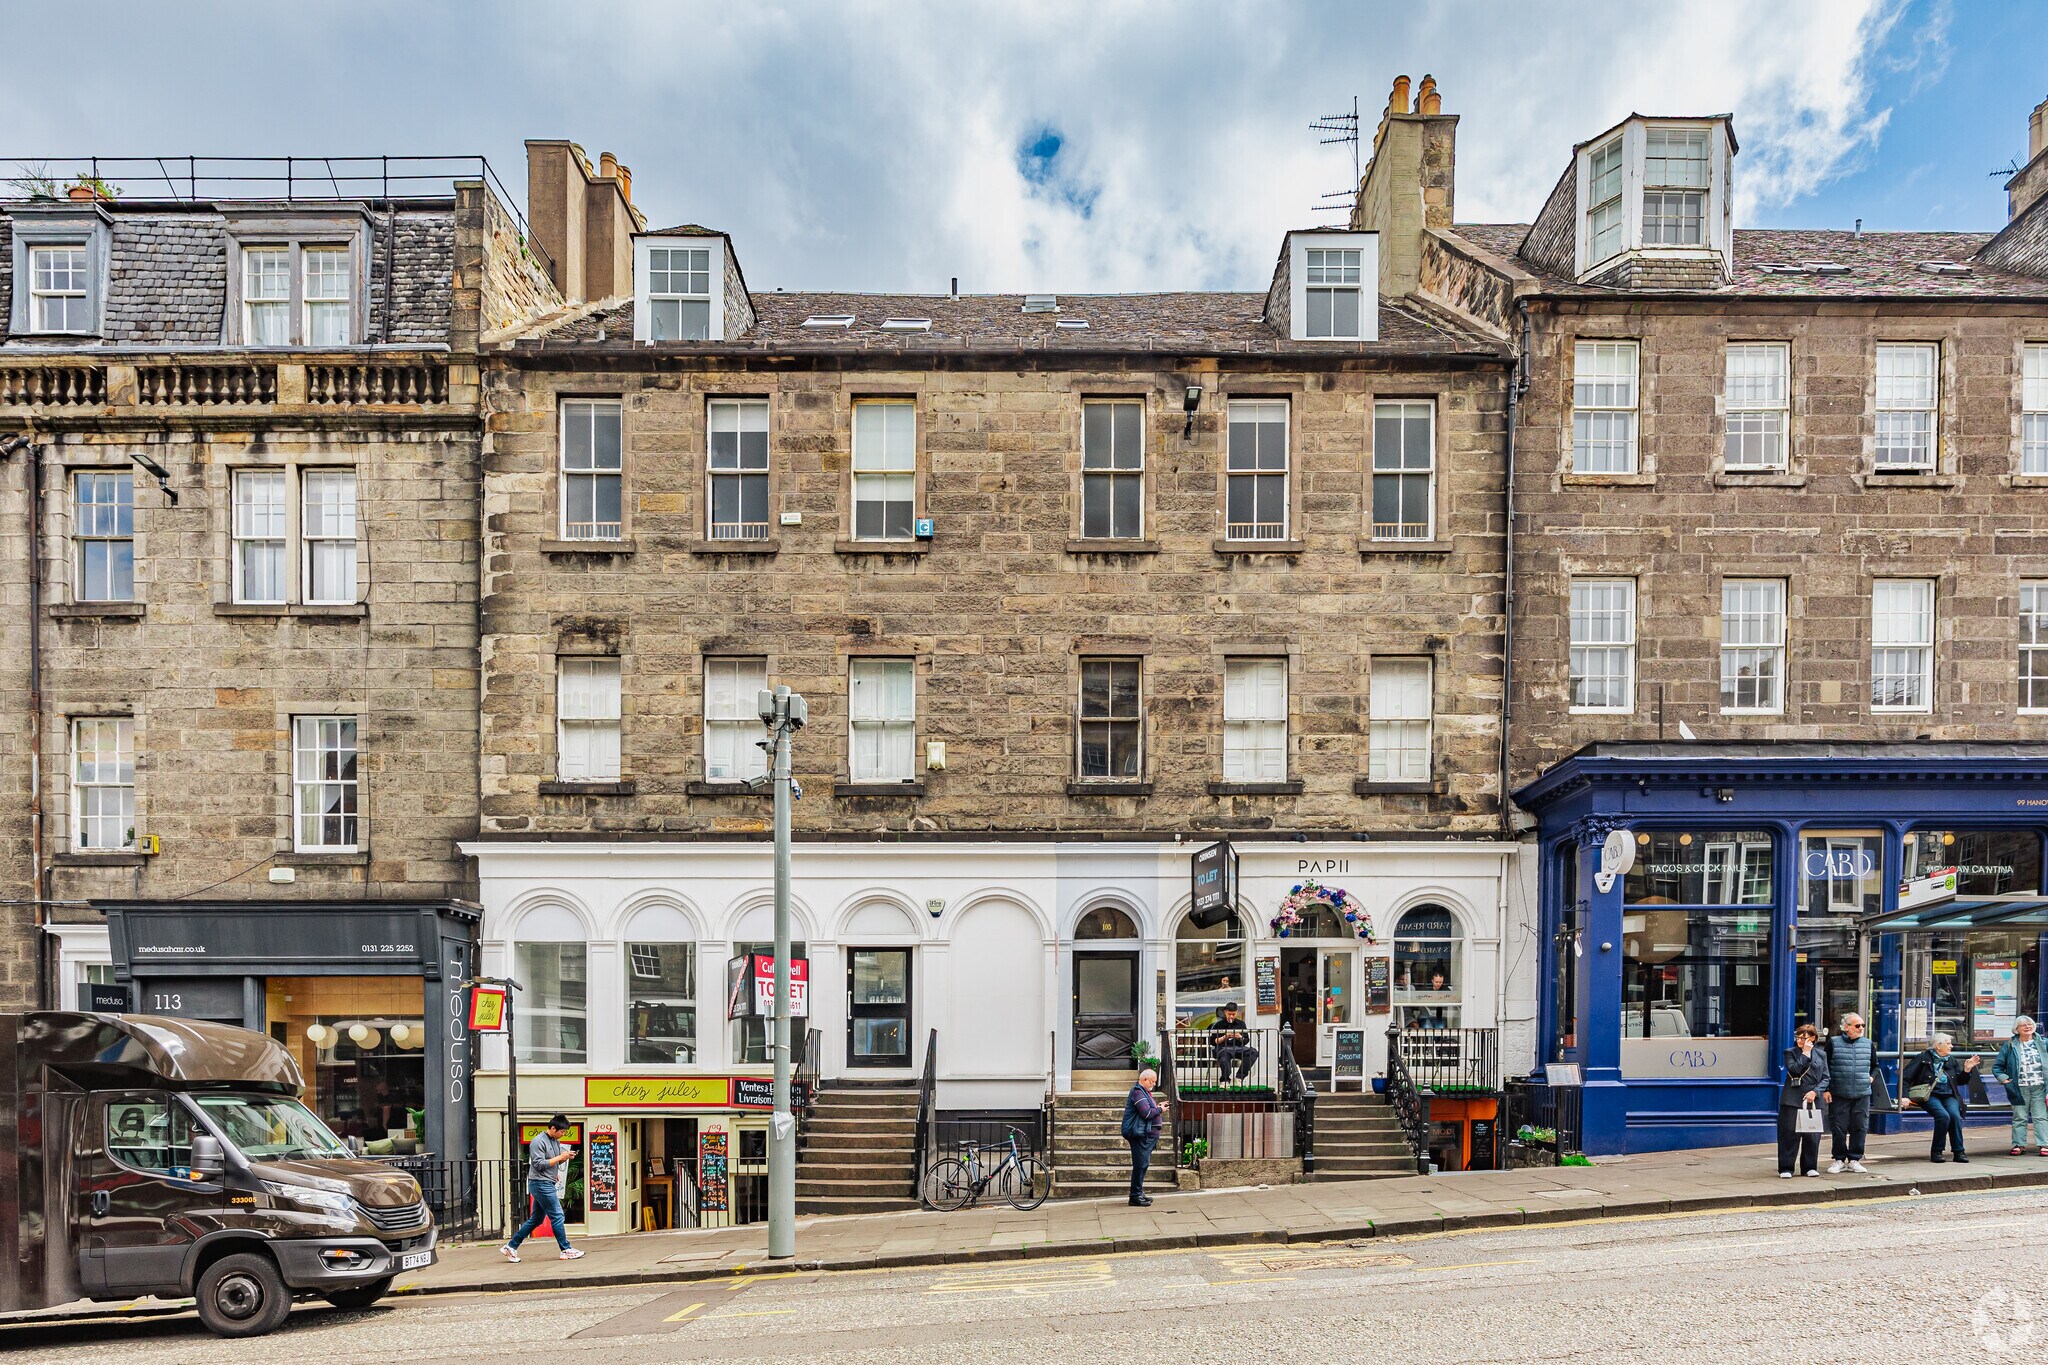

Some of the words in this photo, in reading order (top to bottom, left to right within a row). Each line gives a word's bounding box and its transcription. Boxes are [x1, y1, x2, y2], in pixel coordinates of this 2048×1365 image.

[1199, 848, 1217, 862] ORINSEN
[1298, 859, 1349, 873] PAPII
[1651, 864, 1683, 873] TACOS
[1684, 864, 1691, 873] &
[1692, 864, 1748, 873] COCKTAILS
[1804, 852, 1872, 877] CABO
[1971, 865, 2014, 874] CANTINA
[1197, 873, 1205, 886] TO
[1205, 868, 1218, 883] LET
[1945, 877, 1955, 887] GH
[1102, 923, 1112, 931] 105
[138, 945, 206, 953] medusahair.co.uk
[361, 944, 378, 952] 0131
[380, 944, 395, 952] 225
[396, 944, 414, 952] 2252
[758, 981, 775, 997] TO
[789, 983, 805, 999] ET
[96, 996, 124, 1006] medusa
[154, 994, 182, 1010] 113
[450, 959, 466, 1104] medusa
[1669, 1050, 1717, 1068] CABO
[613, 1082, 650, 1101] chez
[656, 1081, 701, 1101] jules
[740, 1081, 764, 1093] Ventes
[738, 1092, 771, 1104] Livraison
[595, 1123, 613, 1133] 109
[707, 1123, 722, 1133] 109
[231, 1196, 258, 1204] 333005
